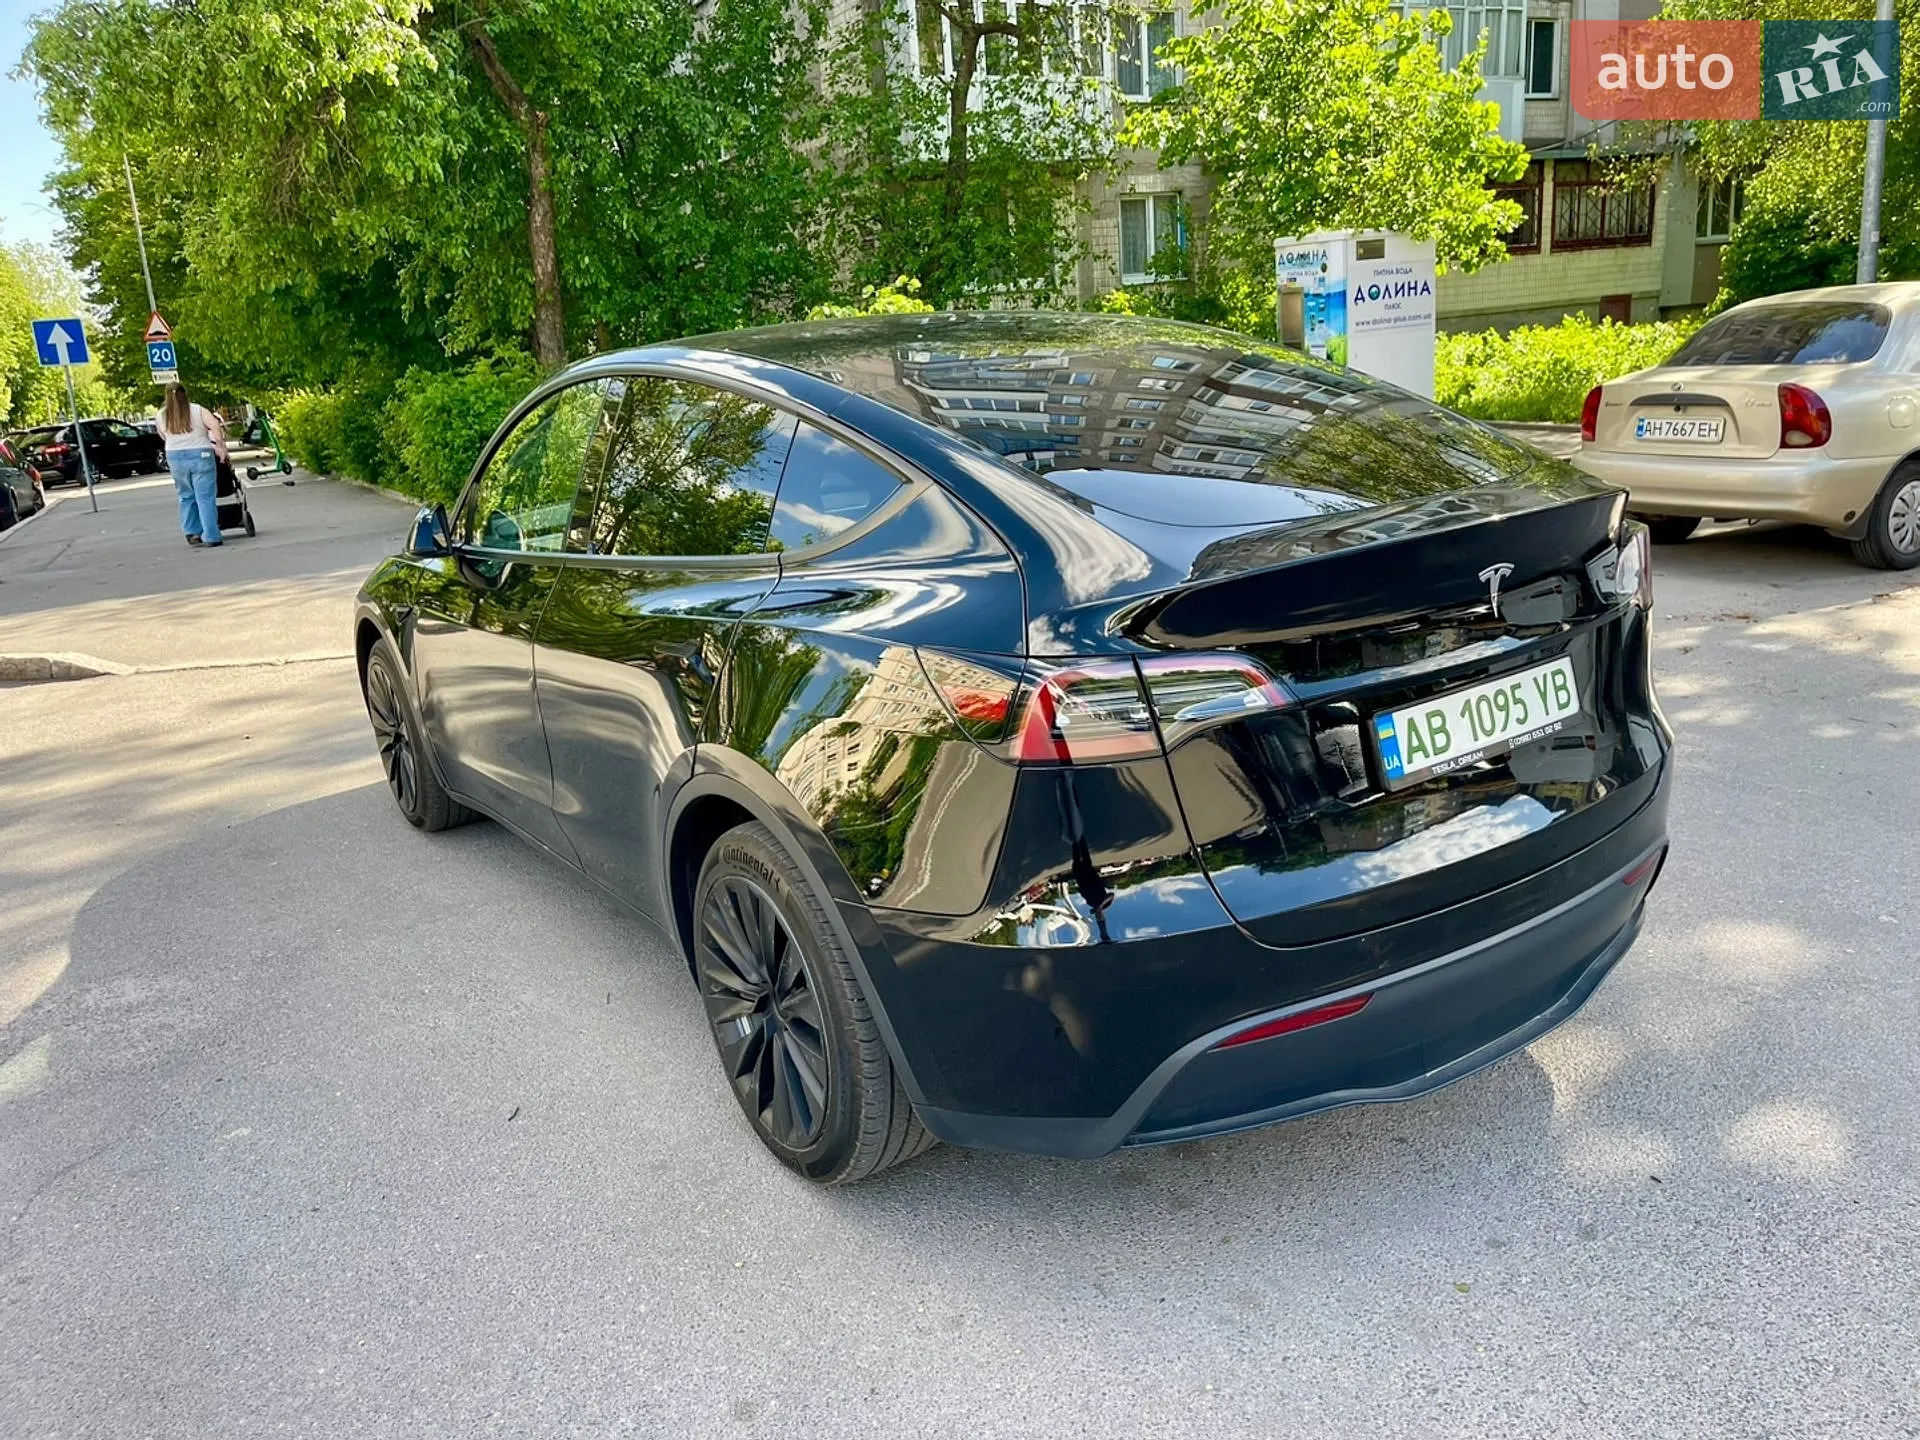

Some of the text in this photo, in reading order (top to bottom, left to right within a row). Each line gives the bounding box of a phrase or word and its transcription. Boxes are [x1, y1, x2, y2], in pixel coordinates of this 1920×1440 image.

[1278, 249, 1328, 266] ДОЛИНА
[1354, 279, 1431, 304] ДОЛИНА
[151, 348, 171, 362] 20
[1645, 421, 1662, 436] AH
[1665, 422, 1695, 437] 7667
[1698, 422, 1719, 437] EH
[1406, 668, 1571, 764] AB 1095 YB
[1384, 756, 1401, 771] UA
[723, 844, 774, 884] Continental
